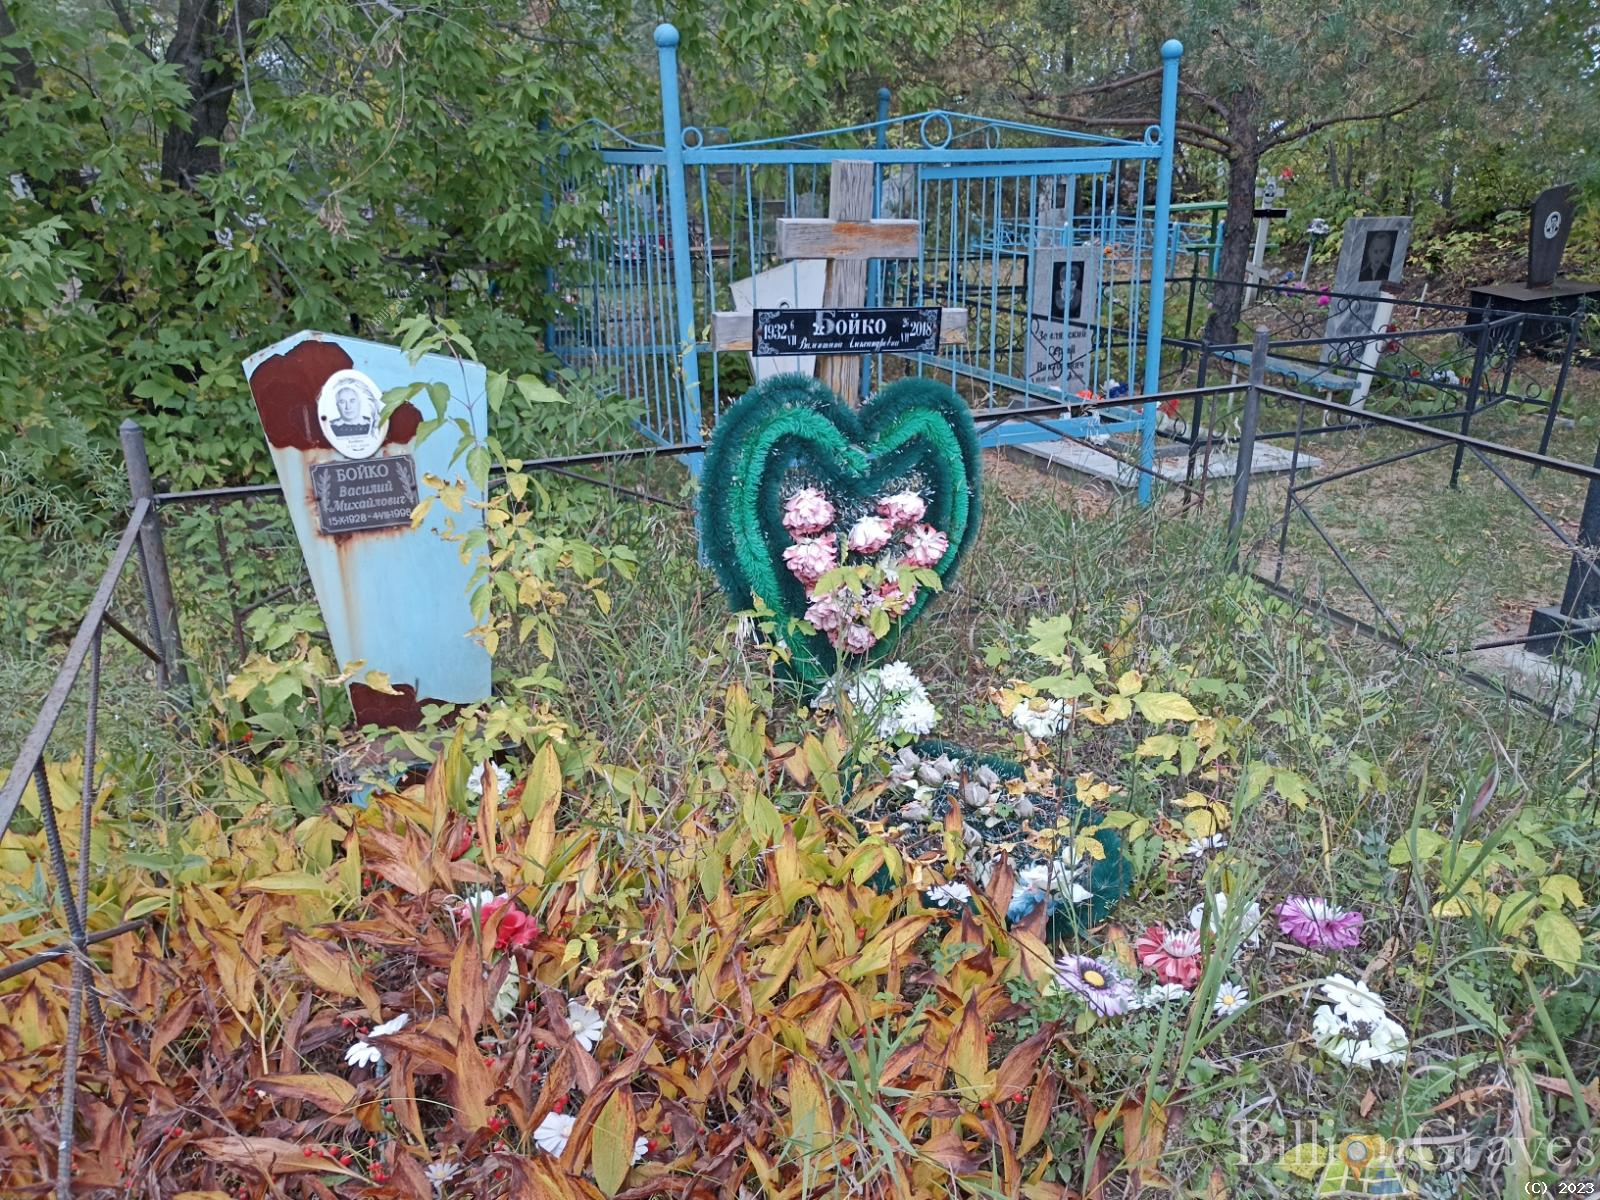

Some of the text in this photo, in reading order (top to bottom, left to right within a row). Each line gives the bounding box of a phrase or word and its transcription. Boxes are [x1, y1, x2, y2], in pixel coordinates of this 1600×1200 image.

[763, 323, 788, 340] 1932
[812, 311, 886, 336] Бойко
[909, 321, 933, 337] 2018
[336, 464, 389, 482] БОЙКО
[339, 480, 393, 498] Василий
[328, 495, 407, 513] Михайлович
